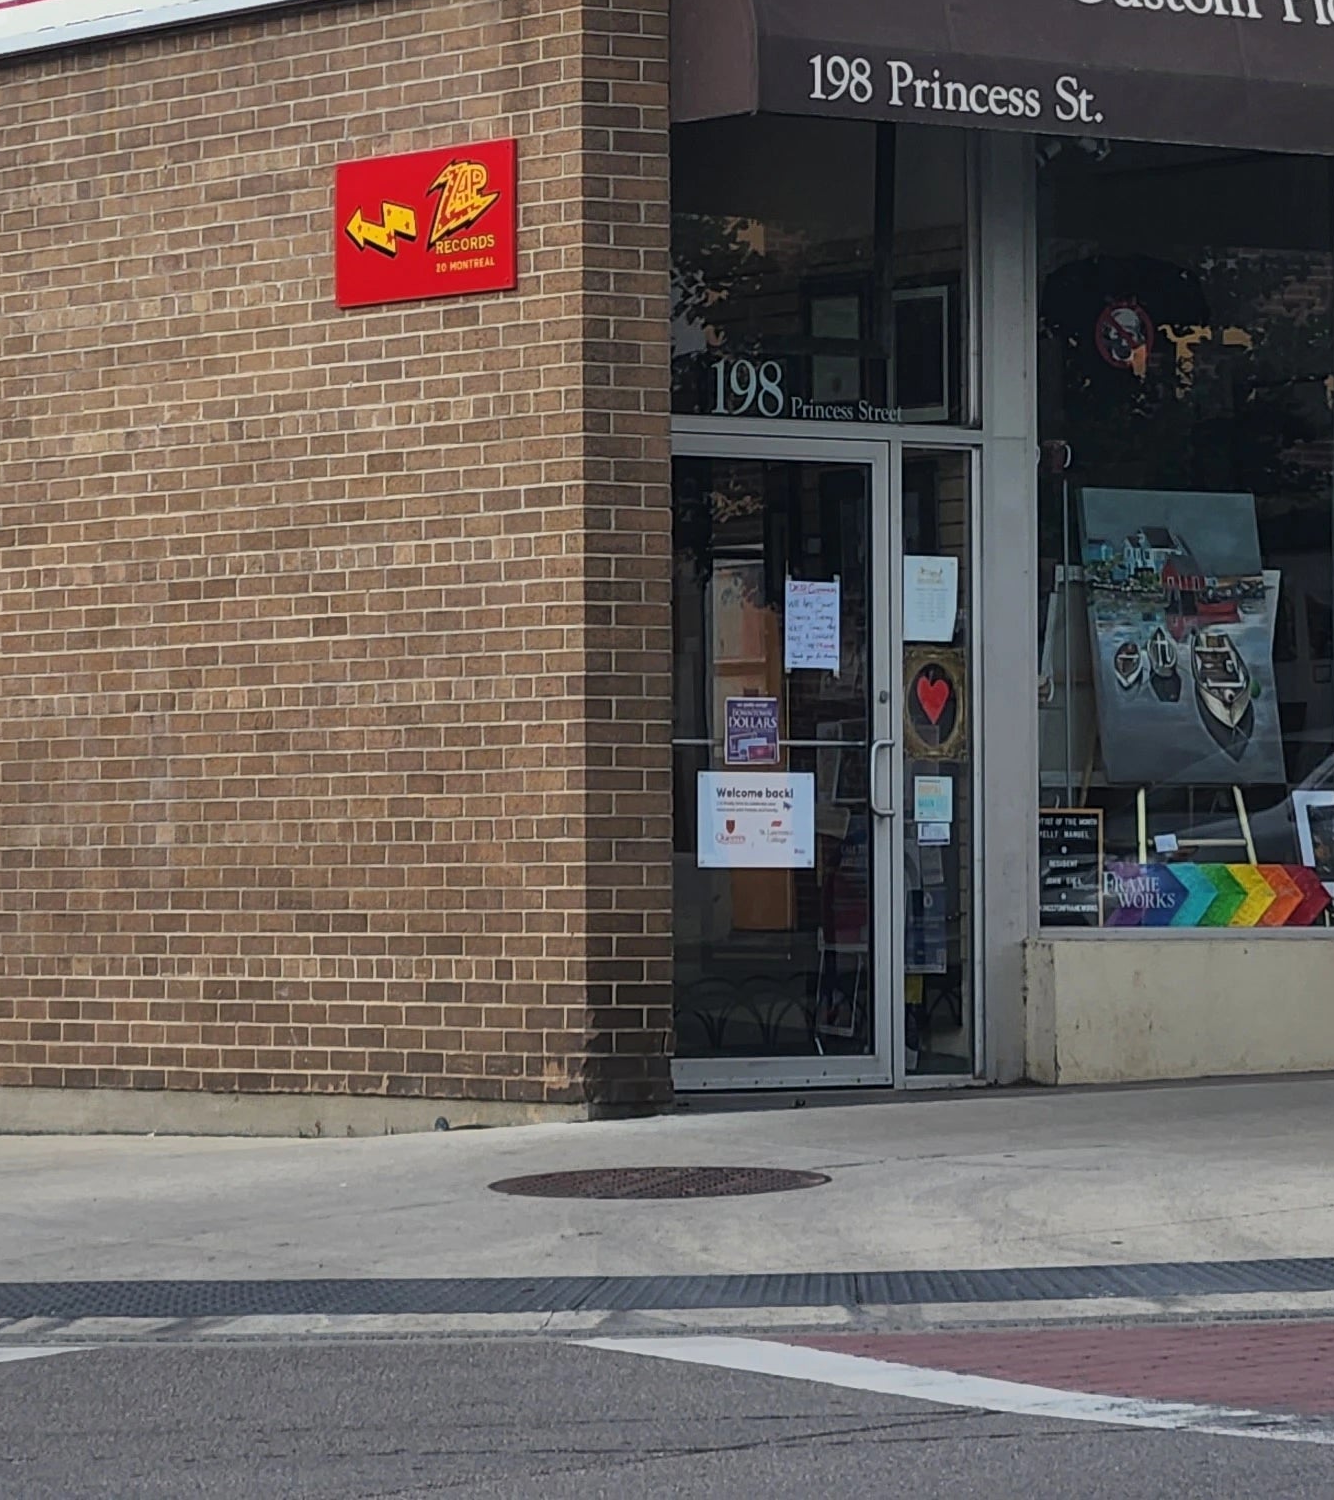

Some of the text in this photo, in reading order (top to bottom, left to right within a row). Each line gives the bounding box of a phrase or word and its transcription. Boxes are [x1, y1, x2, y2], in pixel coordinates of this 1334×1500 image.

[809, 55, 1104, 123] 198 Princess St.
[435, 234, 495, 254] RECORDS
[436, 257, 495, 273] 20 MONTREAL
[711, 358, 903, 422] 198 Princess Street
[729, 716, 777, 729] DOLLARS
[716, 787, 794, 799] Welcome back!
[1102, 871, 1160, 896] FRAME
[1116, 892, 1176, 910] WORKS
